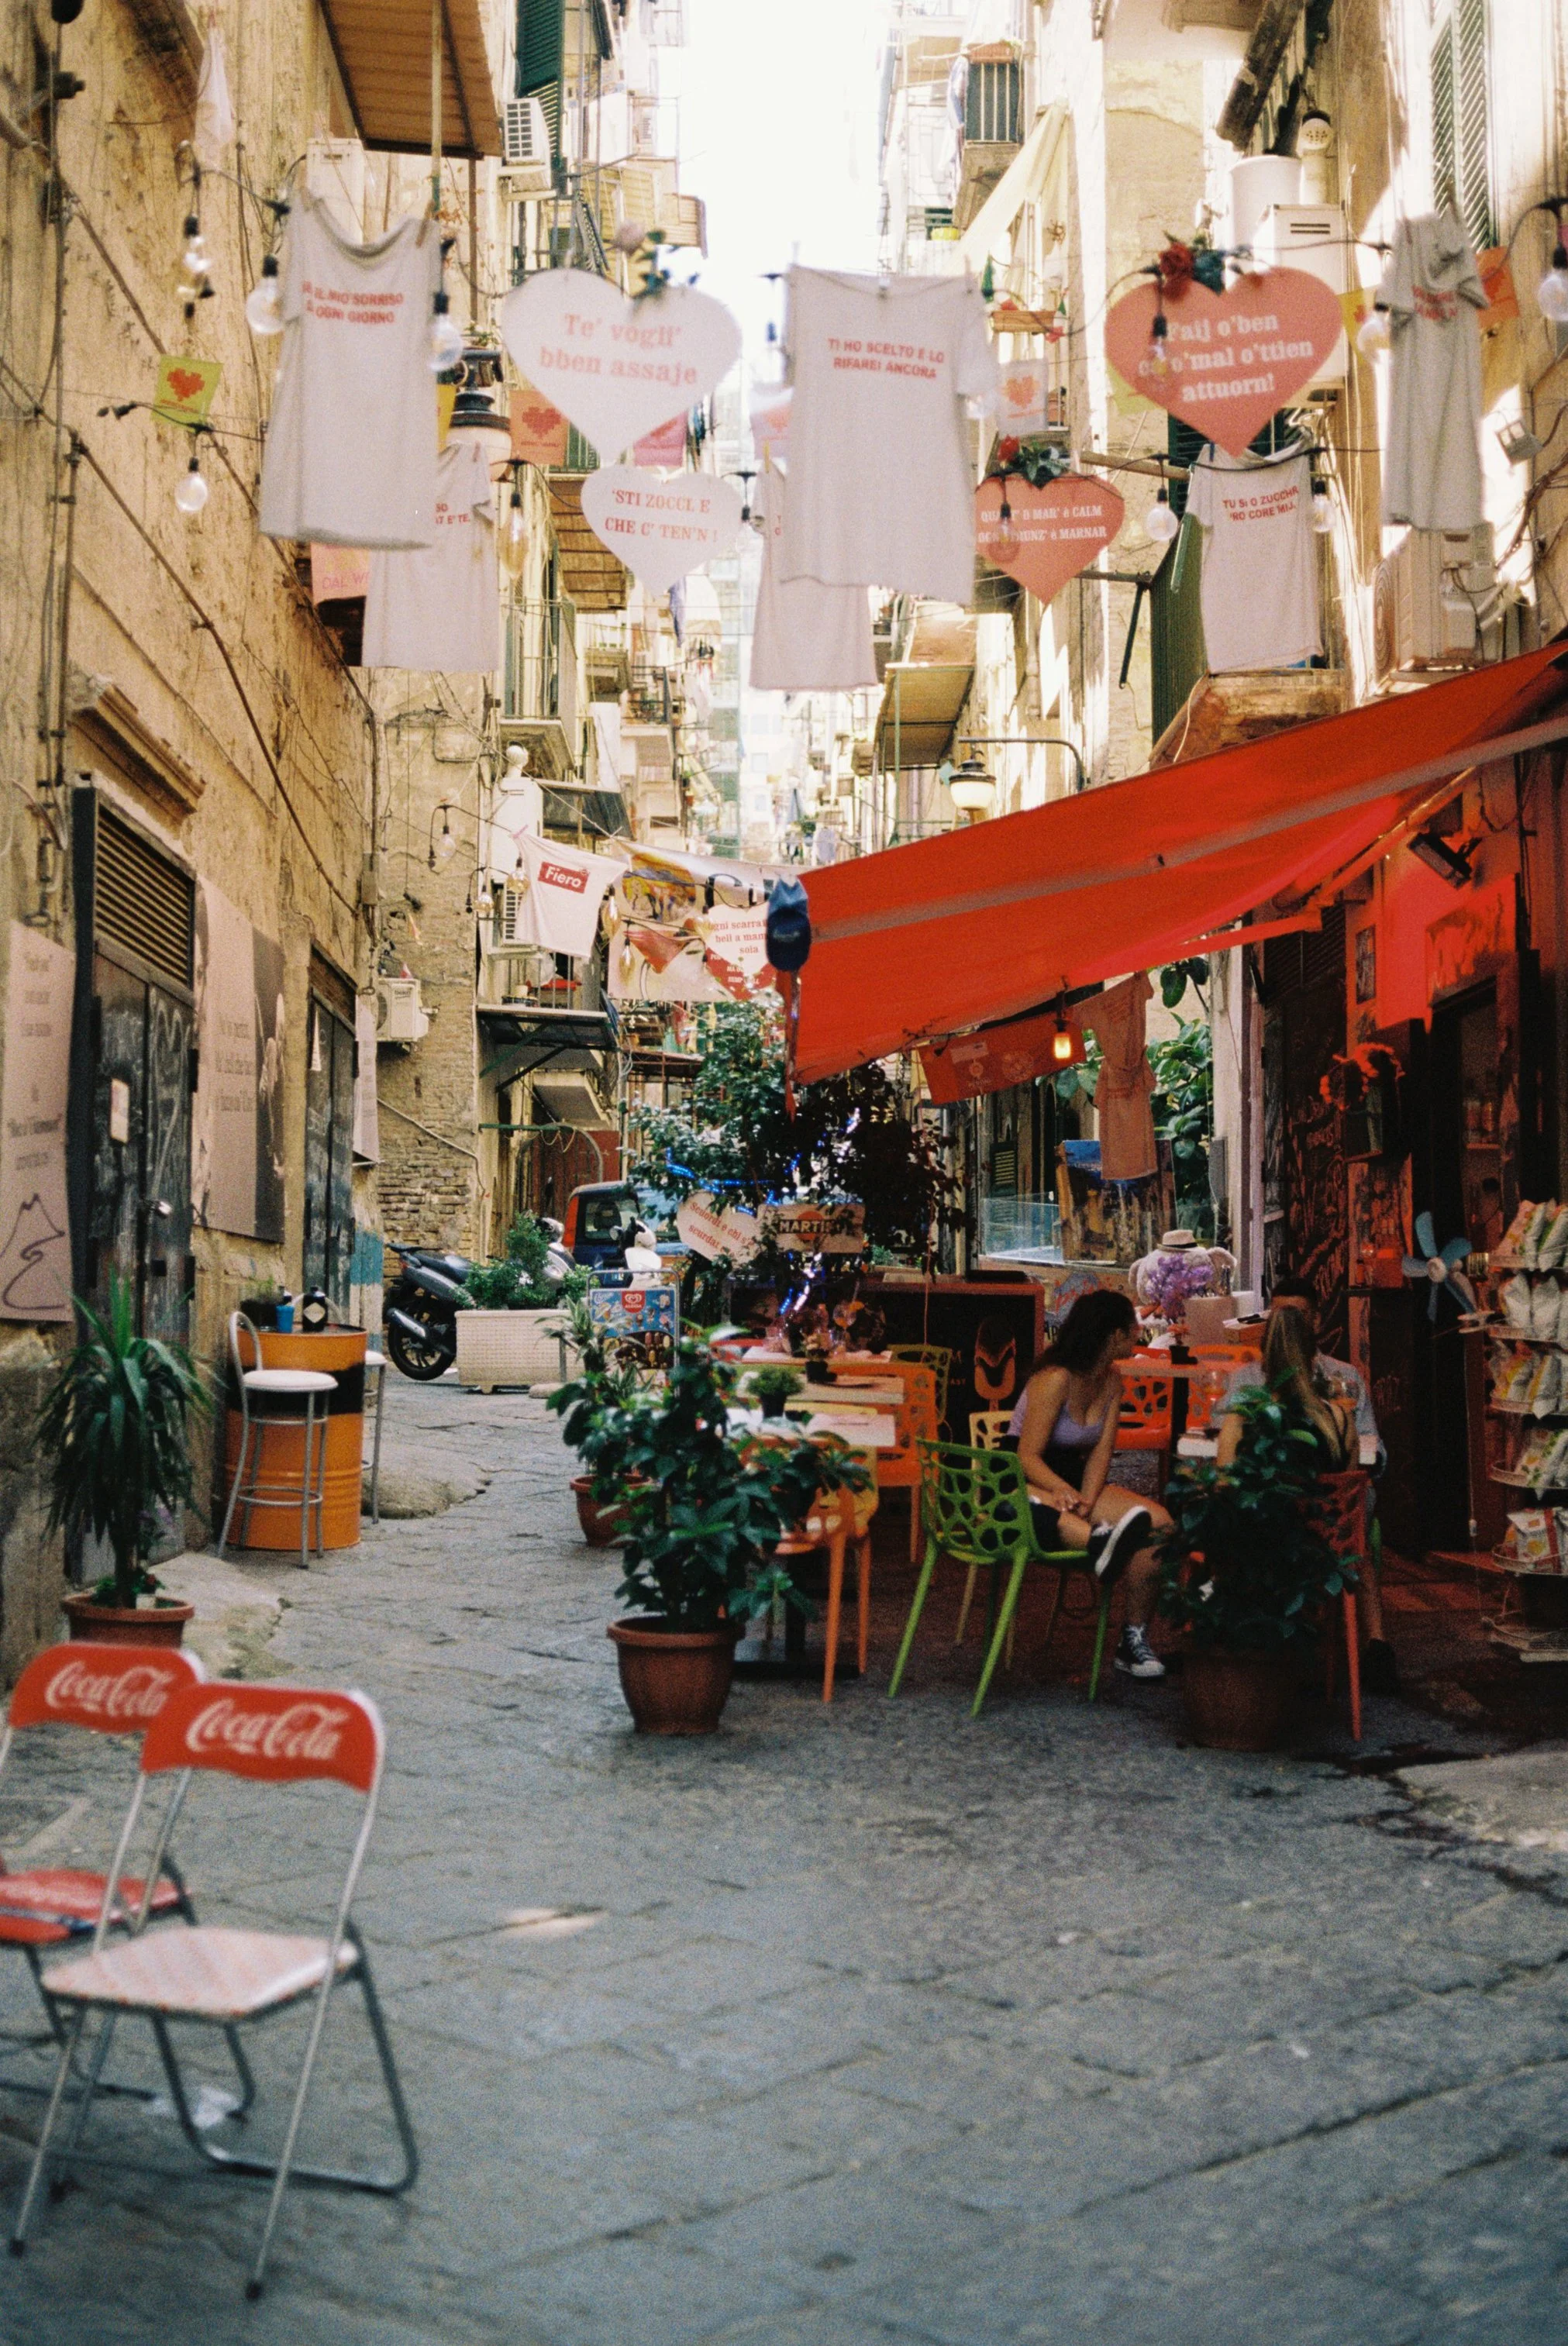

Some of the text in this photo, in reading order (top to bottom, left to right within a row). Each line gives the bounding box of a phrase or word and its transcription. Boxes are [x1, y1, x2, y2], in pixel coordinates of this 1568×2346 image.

[353, 291, 404, 306] SORRISO
[347, 311, 395, 323] GIORNO
[843, 341, 862, 353] HO
[866, 343, 914, 358] SCELTO
[539, 346, 696, 387] bben assaje
[886, 362, 937, 379] ANCORA
[1223, 499, 1235, 509] TU
[1260, 485, 1299, 505] ZUCCHR
[1073, 505, 1103, 518] CALM
[1249, 507, 1276, 520] CORE
[605, 517, 636, 534] CHE
[545, 866, 581, 888] Fiero
